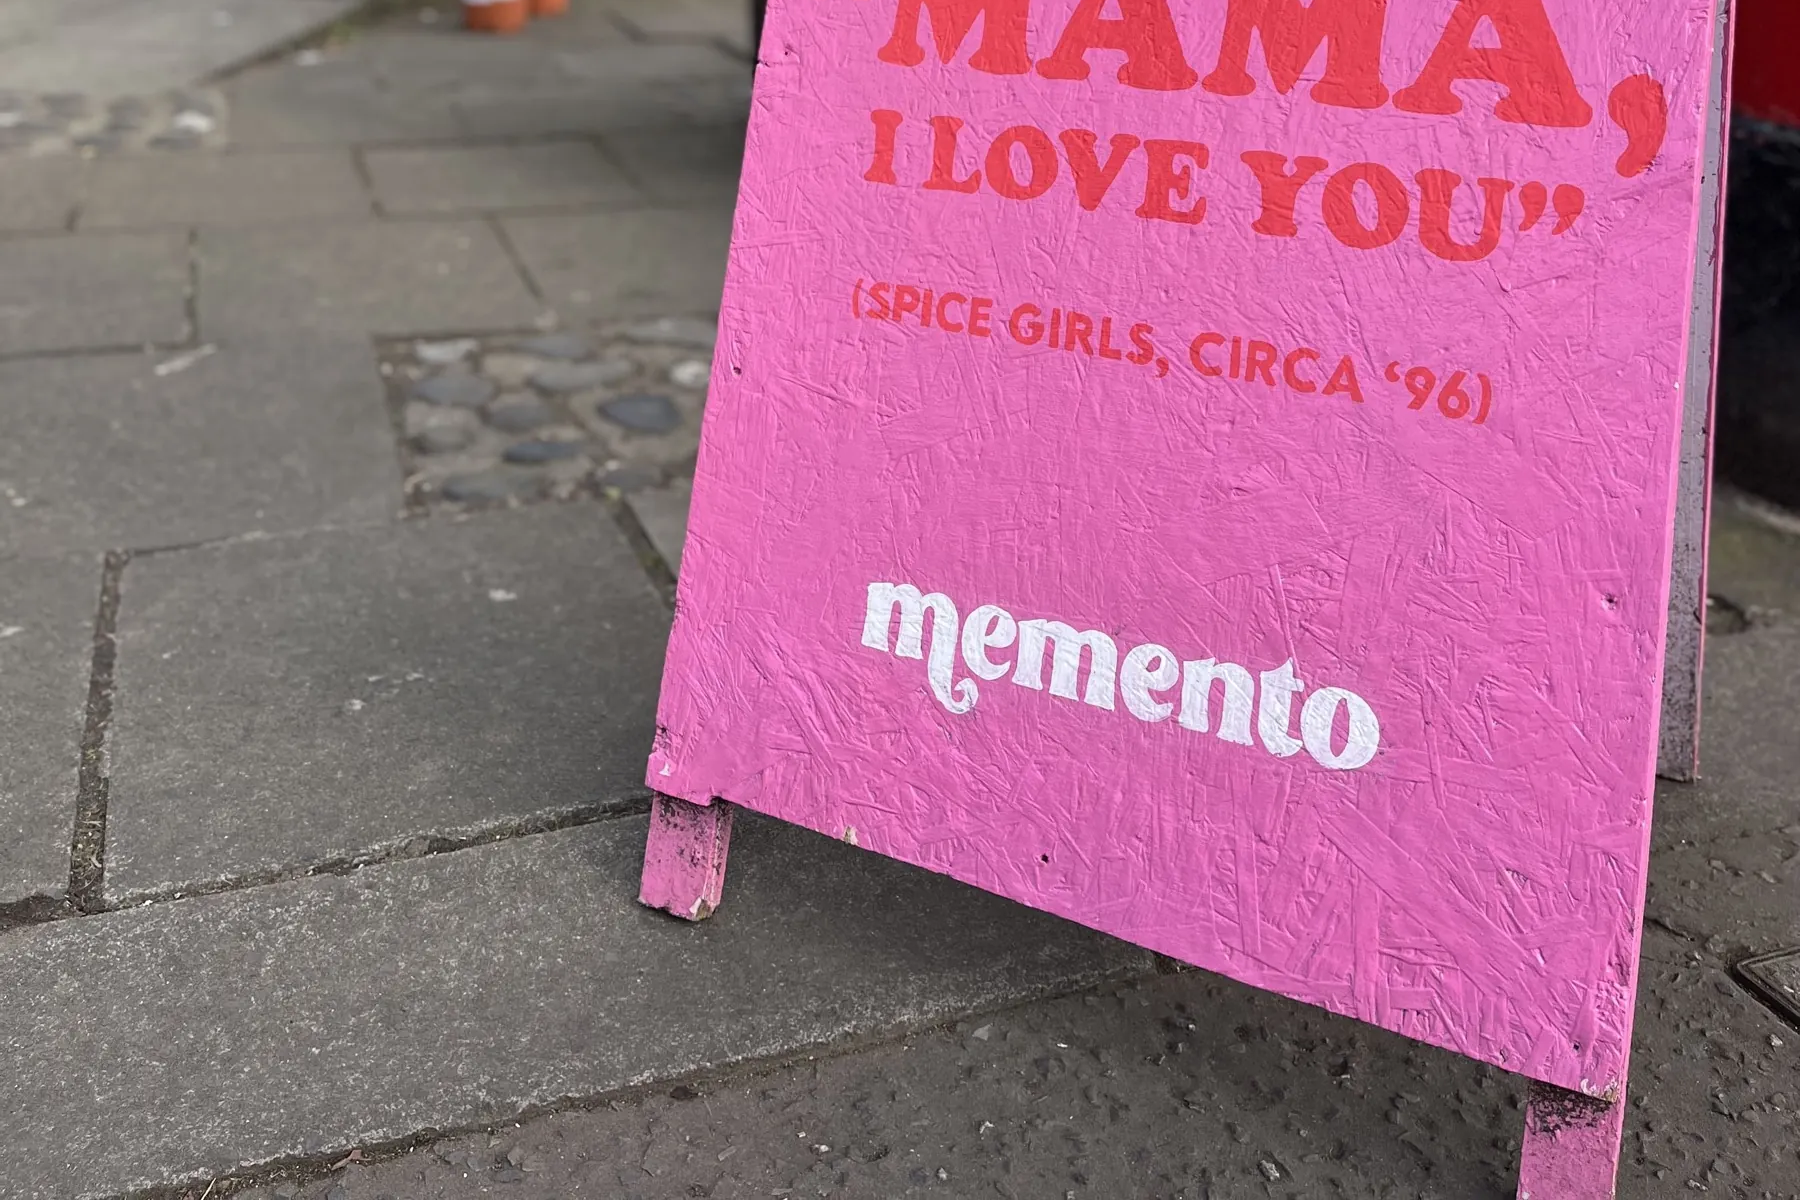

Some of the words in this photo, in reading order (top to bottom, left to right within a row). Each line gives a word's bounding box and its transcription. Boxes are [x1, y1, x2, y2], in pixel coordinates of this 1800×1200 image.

[864, 108, 904, 184] I
[922, 114, 1210, 225] LOVE
[1238, 149, 1586, 262] YOU”
[851, 278, 994, 338] (SPICE
[1008, 303, 1170, 379] GIRLS,
[1188, 331, 1365, 404] CIRCA
[1383, 359, 1493, 425] ‘96)
[861, 581, 1381, 770] memento
